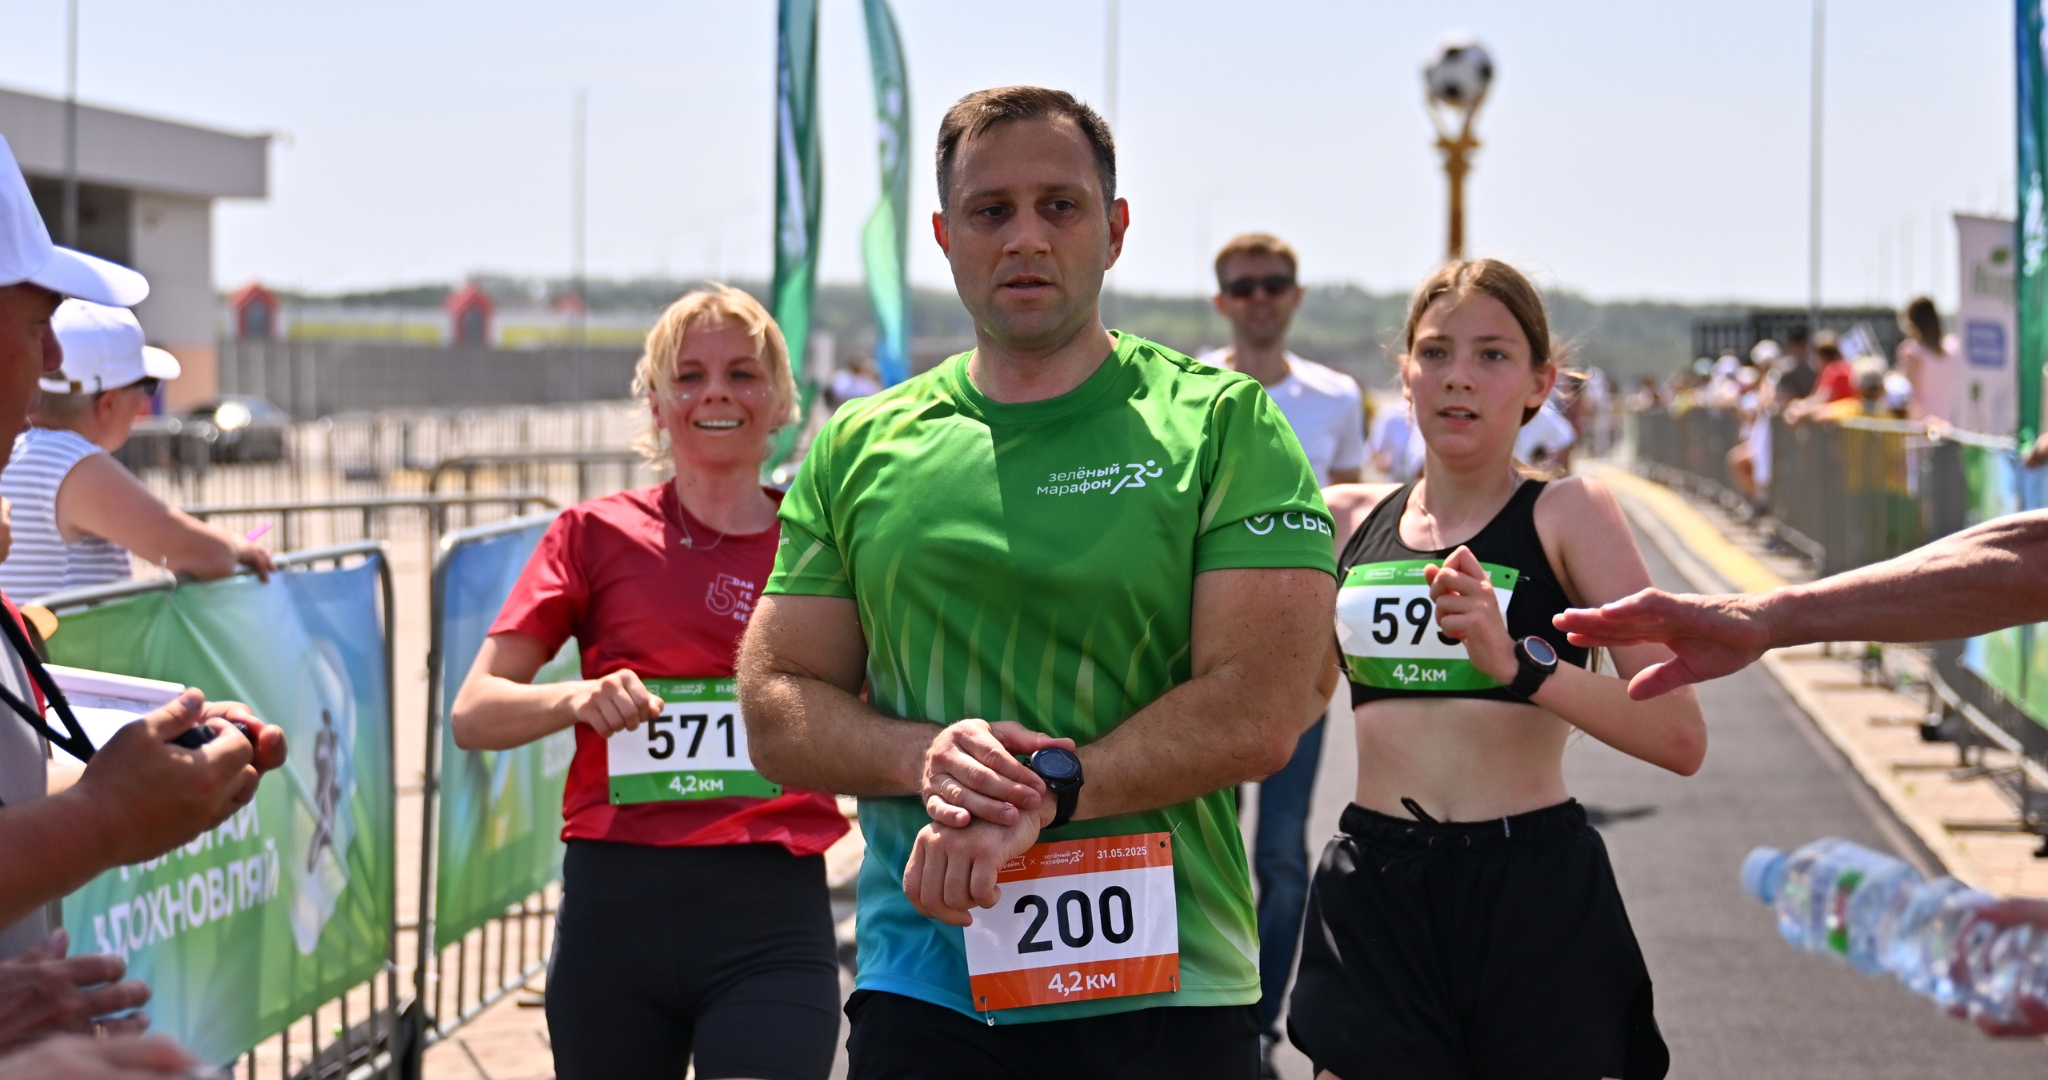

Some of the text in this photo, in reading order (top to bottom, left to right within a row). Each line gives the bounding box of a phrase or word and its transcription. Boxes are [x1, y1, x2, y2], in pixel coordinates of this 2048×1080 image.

[1036, 478, 1112, 497] марафон
[1048, 463, 1120, 483] зелёный
[1371, 596, 1463, 646] 59
[647, 714, 736, 761] 571
[1096, 846, 1148, 860] 31.05.2025
[1013, 885, 1134, 955] 200
